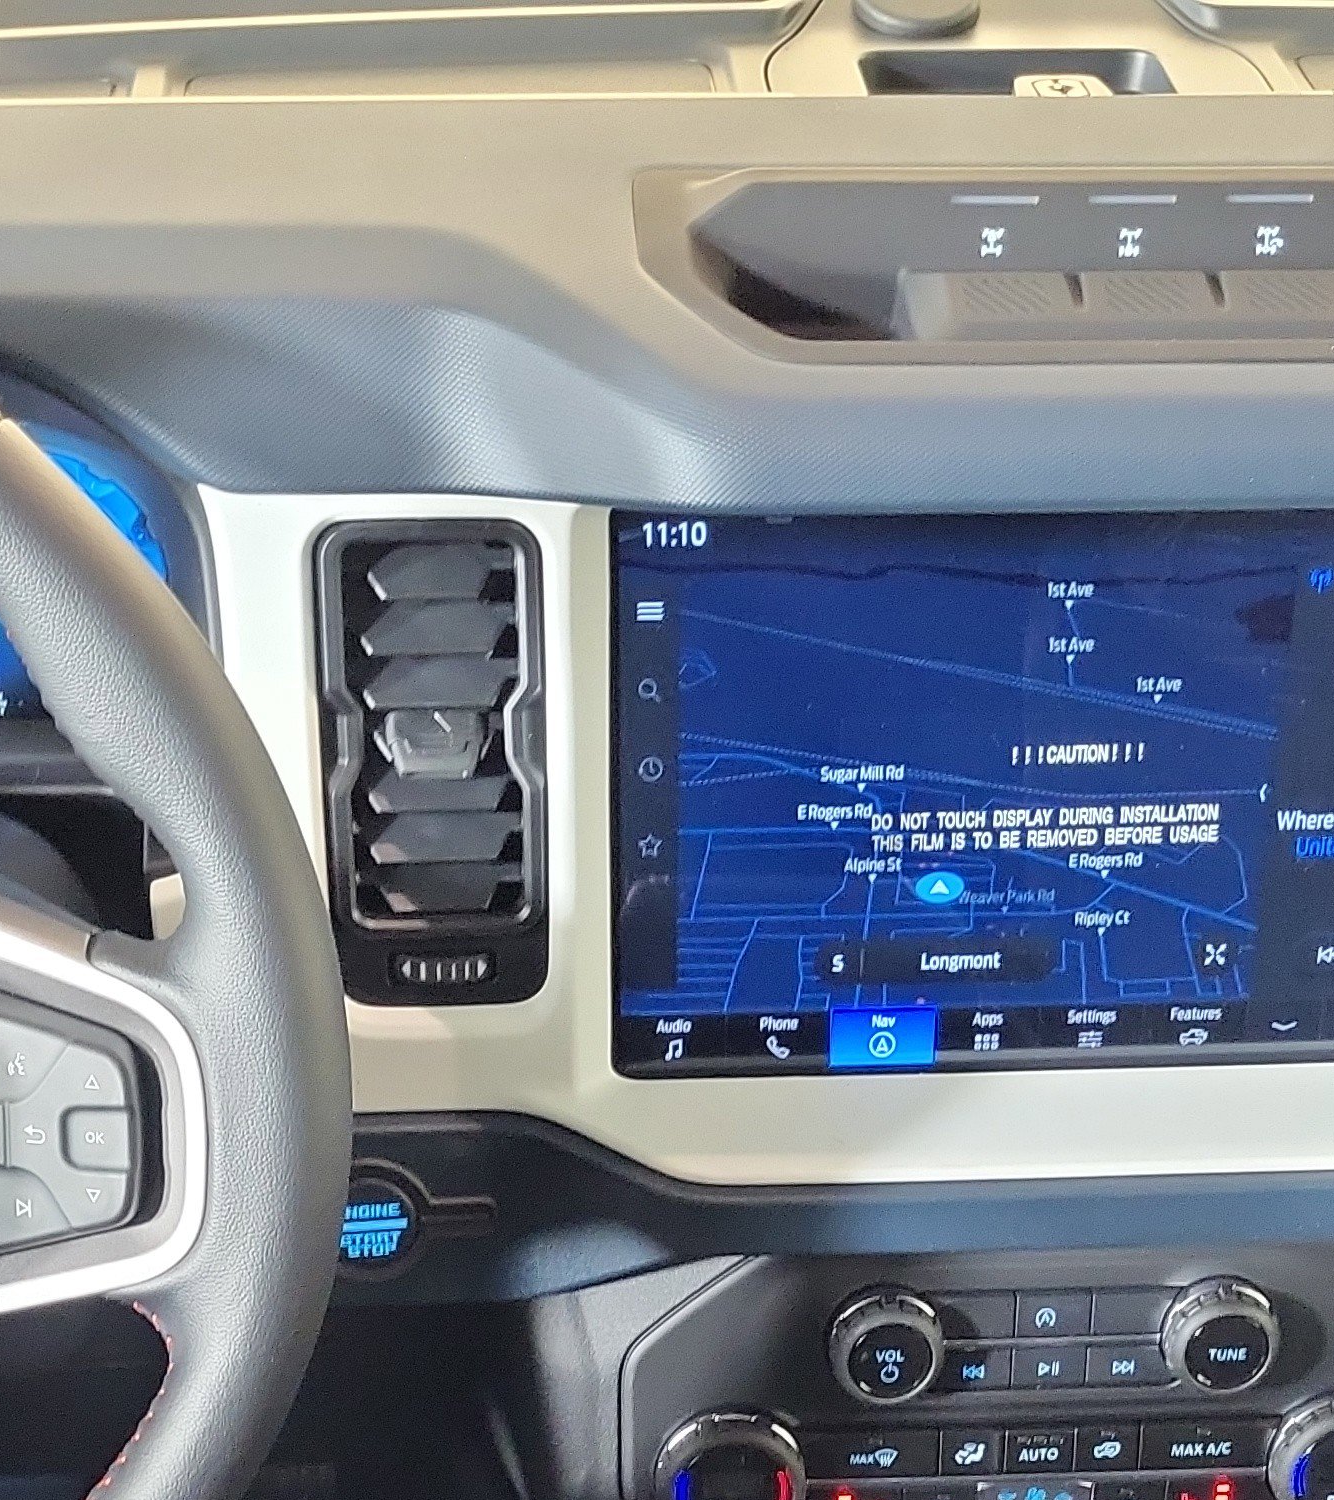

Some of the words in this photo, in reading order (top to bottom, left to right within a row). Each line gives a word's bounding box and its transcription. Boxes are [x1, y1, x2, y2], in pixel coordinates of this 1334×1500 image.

[642, 521, 708, 549] 11:10
[1048, 581, 1066, 598] 1st
[1067, 581, 1095, 597] Ave
[1049, 637, 1067, 653] 1st
[1068, 637, 1095, 652] Ave
[1136, 676, 1154, 692] 1st
[1156, 676, 1182, 692] Ave
[820, 765, 858, 784] Sugar
[859, 764, 884, 781] Mill
[886, 764, 905, 780] Rd
[808, 804, 853, 820] Rogers
[854, 803, 873, 818] Rd
[871, 813, 893, 832] DO
[900, 812, 931, 831] NOT
[936, 811, 986, 830] TOUCH
[992, 808, 1054, 828] DISPLAY
[1058, 806, 1114, 827] DURING
[1119, 803, 1220, 824] INSTALLATION
[1277, 809, 1334, 831] Where
[872, 834, 904, 853] THIS
[911, 833, 944, 851] FILM
[951, 832, 966, 850] IS
[972, 831, 993, 850] TO
[999, 830, 1021, 849] BE
[1026, 828, 1098, 848] REMOVED
[1104, 826, 1163, 846] BEFORE
[1169, 824, 1220, 844] USAGE
[844, 857, 886, 874] Alpine
[887, 856, 903, 871] St
[1068, 856, 1078, 869] E
[1079, 853, 1124, 871] Rogers
[1125, 852, 1144, 867] Rd
[1038, 888, 1055, 902] Rd
[1074, 911, 1113, 928] Ripley
[1114, 910, 1131, 925] Ct
[832, 954, 844, 972] S
[921, 952, 1002, 972] Longmont
[872, 1014, 896, 1028] Nav
[973, 1011, 1003, 1029] Apps
[1067, 1008, 1117, 1026] Settings
[1170, 1006, 1223, 1021] Features
[656, 1017, 692, 1034] Audio
[760, 1015, 798, 1031] Phone
[85, 1131, 105, 1145] OK
[345, 1202, 402, 1221] NGINE
[875, 1348, 906, 1364] VOL
[1208, 1346, 1248, 1363] TUNE
[1018, 1446, 1059, 1463] AUTO
[1170, 1443, 1205, 1458] MAX
[1206, 1440, 1232, 1457] A/C
[849, 1452, 876, 1466] MAX
